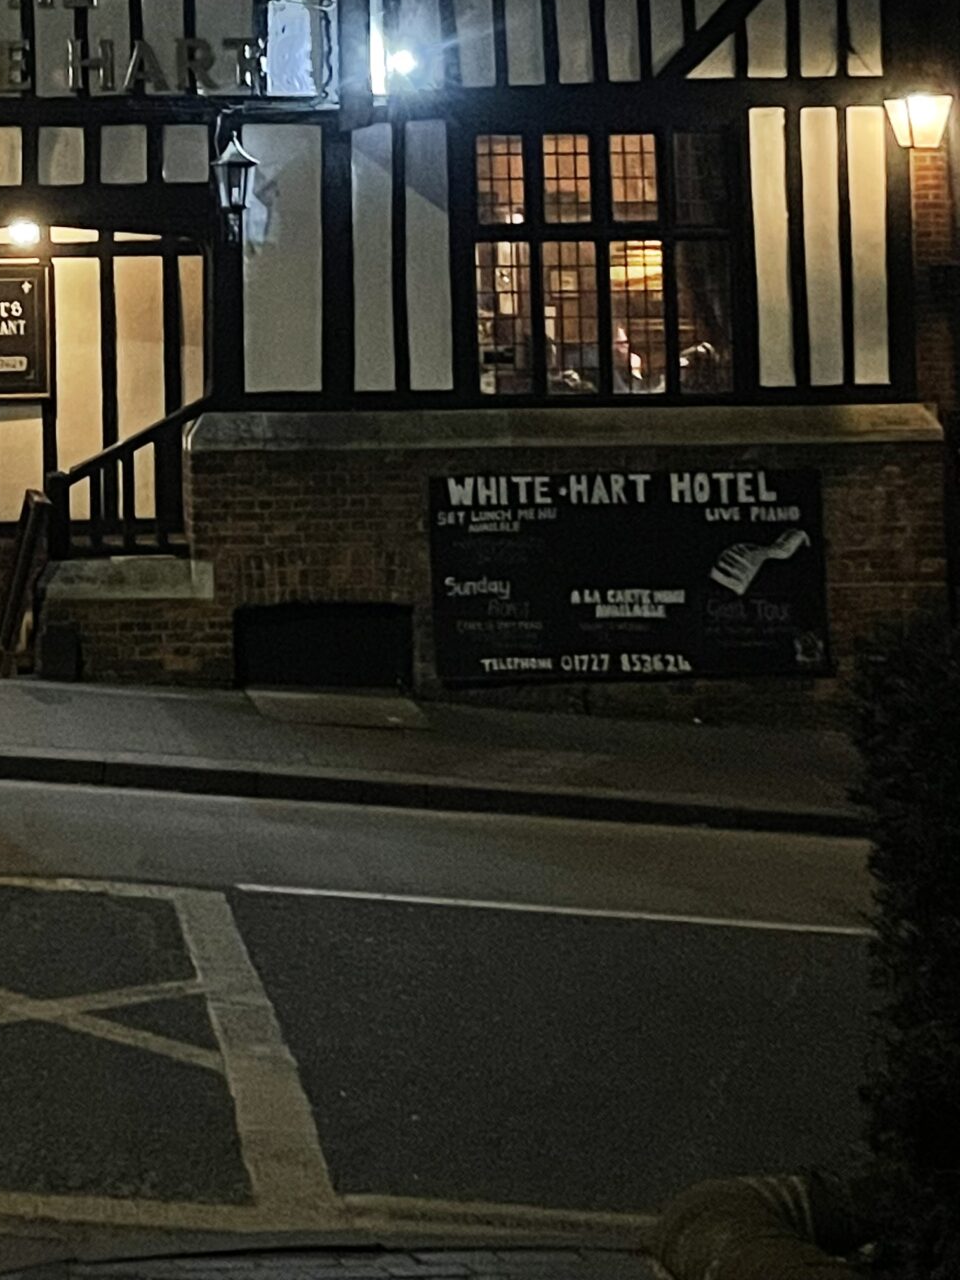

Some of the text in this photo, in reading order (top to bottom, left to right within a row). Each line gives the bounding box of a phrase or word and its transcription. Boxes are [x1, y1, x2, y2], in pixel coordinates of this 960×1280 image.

[66, 36, 268, 92] HART
[447, 471, 778, 506] WHITE HART HOTEL
[705, 505, 801, 522] LIVE PIANO
[443, 575, 512, 600] Sunday
[560, 653, 611, 672] 01727
